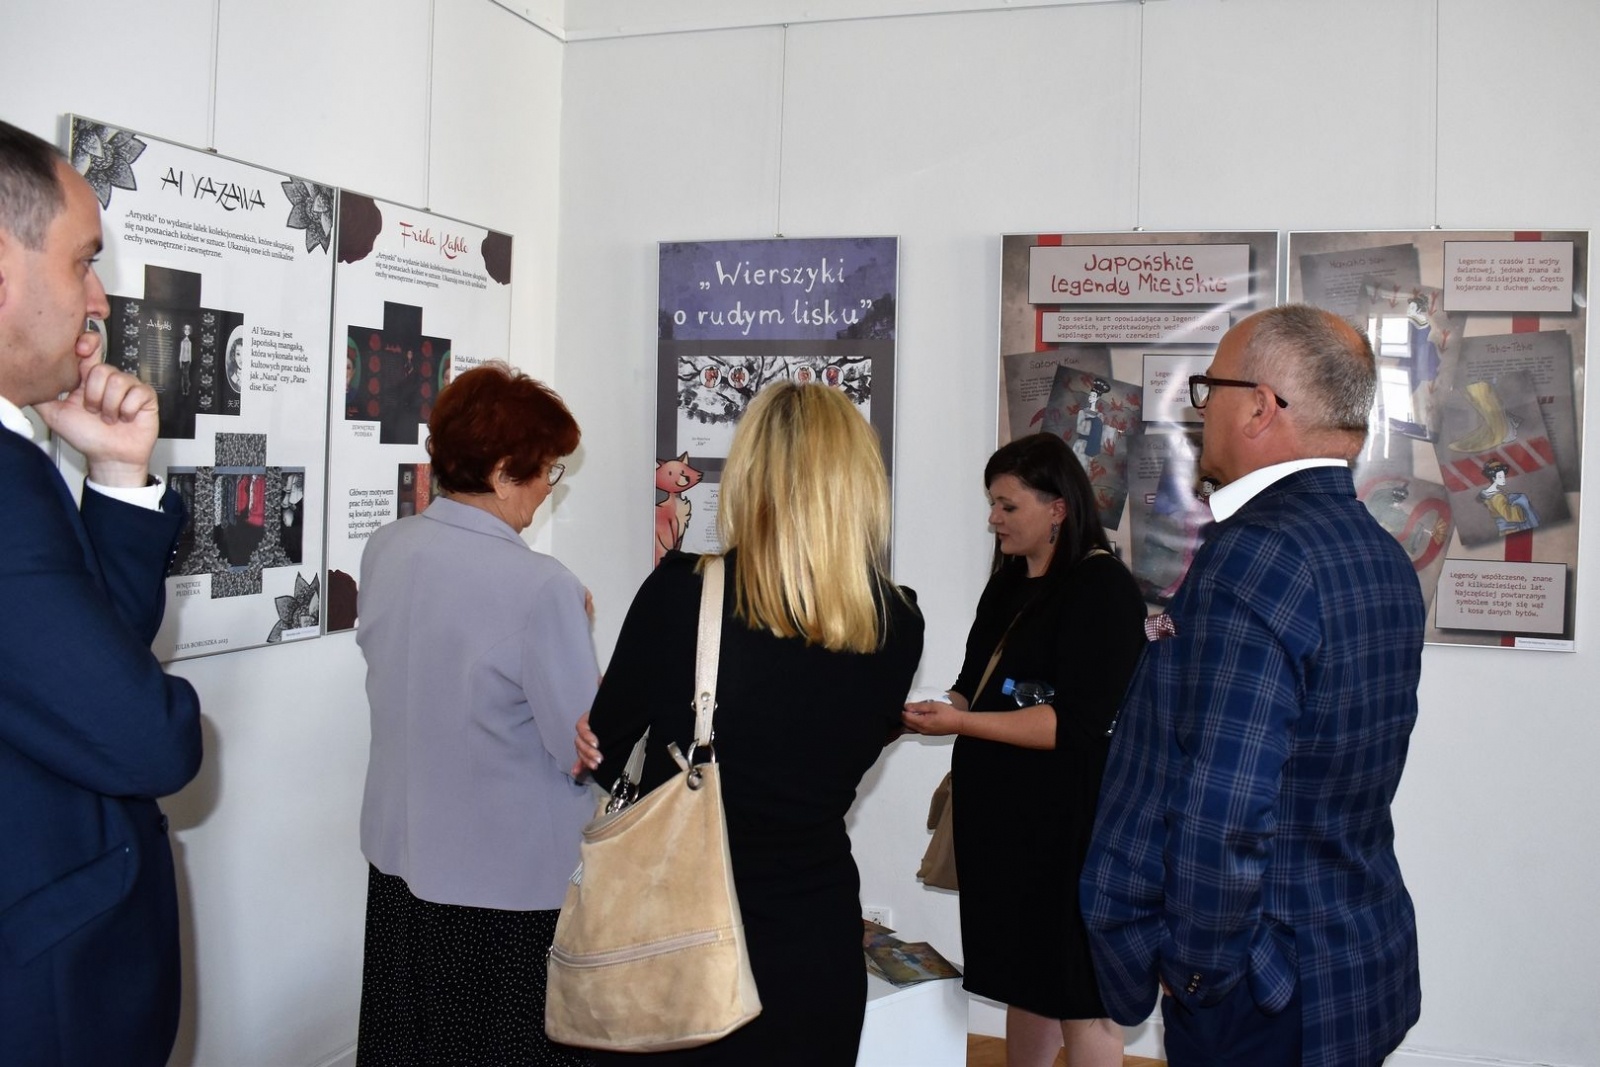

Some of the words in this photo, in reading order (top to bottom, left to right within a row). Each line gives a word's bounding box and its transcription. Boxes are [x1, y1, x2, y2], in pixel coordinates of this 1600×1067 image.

[191, 173, 266, 212] YAZAWA
[158, 216, 166, 224] to
[166, 217, 193, 231] wydanie
[193, 222, 208, 233] lalek
[208, 224, 257, 244] kolekcjonerskich,
[258, 237, 273, 247] które
[273, 239, 295, 254] skupiają
[399, 221, 436, 249] Frida
[439, 231, 468, 260] Kahlo
[124, 221, 135, 232] się
[135, 223, 144, 232] na
[145, 225, 180, 239] postaciach
[180, 228, 200, 243] kobiet
[206, 238, 227, 249] sztuce.
[227, 241, 250, 257] Ukazują
[250, 246, 262, 255] one
[261, 246, 271, 257] ich
[271, 248, 294, 262] unikalne
[124, 233, 144, 245] cechy
[144, 236, 184, 252] wewnętrzne
[187, 246, 223, 259] zewnętrzne.
[1084, 251, 1195, 275] Japońskie
[1458, 257, 1487, 267] Legenda
[1498, 256, 1524, 265] czasów
[1538, 258, 1560, 267] wojny
[699, 257, 845, 293] „Wierszyki
[1457, 266, 1497, 275] światowej,
[1500, 266, 1525, 275] jednak
[1553, 265, 1561, 274] aż
[1051, 274, 1131, 297] legendy
[1138, 272, 1228, 297] Miejskie
[1453, 275, 1462, 283] do
[1465, 275, 1483, 283] dnia
[1485, 275, 1536, 285] dzisiejszego.
[1539, 275, 1564, 285] Często
[1456, 284, 1492, 293] kojarzona
[1503, 284, 1529, 292] duchem
[1532, 285, 1561, 293] wodnym.
[673, 311, 687, 326] o
[697, 300, 785, 336] rudym
[1114, 315, 1162, 324] opowiadająca
[260, 327, 280, 338] Yazawa
[282, 330, 293, 339] jest
[1057, 324, 1099, 332] Japońskich,
[1102, 324, 1161, 333] przedstawionych
[1057, 332, 1092, 340] wspólnego
[1095, 332, 1121, 340] motywu:
[1125, 331, 1164, 339] czerwieni.
[251, 338, 277, 350] Japońską
[251, 348, 267, 358] która
[267, 351, 294, 361] wykonała
[294, 354, 309, 363] wiele
[250, 360, 280, 372] kultowych
[280, 364, 293, 374] prac
[293, 365, 311, 374] takich
[250, 371, 259, 381] jak
[280, 376, 290, 385] czy
[249, 382, 262, 392] dise
[349, 488, 368, 498] Główny
[369, 488, 394, 498] motywem
[349, 501, 361, 509] prac
[361, 499, 375, 509] Fridy
[375, 498, 390, 507] Kahlo
[348, 511, 355, 519] są
[355, 509, 373, 519] kwiaty,
[377, 509, 391, 517] także
[348, 521, 365, 531] użycie
[365, 519, 382, 530] ciepłej
[1450, 571, 1478, 580] Legendy
[1481, 572, 1528, 583] współczesne,
[176, 581, 201, 590] WNĘTRZE
[1467, 581, 1527, 591] kilkudziesięciu
[1530, 583, 1546, 591] lat.
[175, 588, 201, 597] PUDEŁKA
[1455, 589, 1497, 599] Najczęściej
[1501, 591, 1546, 600] powtarzanym
[1456, 599, 1489, 607] symbolem
[1492, 599, 1513, 608] staje
[1516, 600, 1528, 609] się
[1531, 602, 1544, 610] wąż
[1487, 608, 1512, 616] danych
[1515, 609, 1539, 617] bytów.
